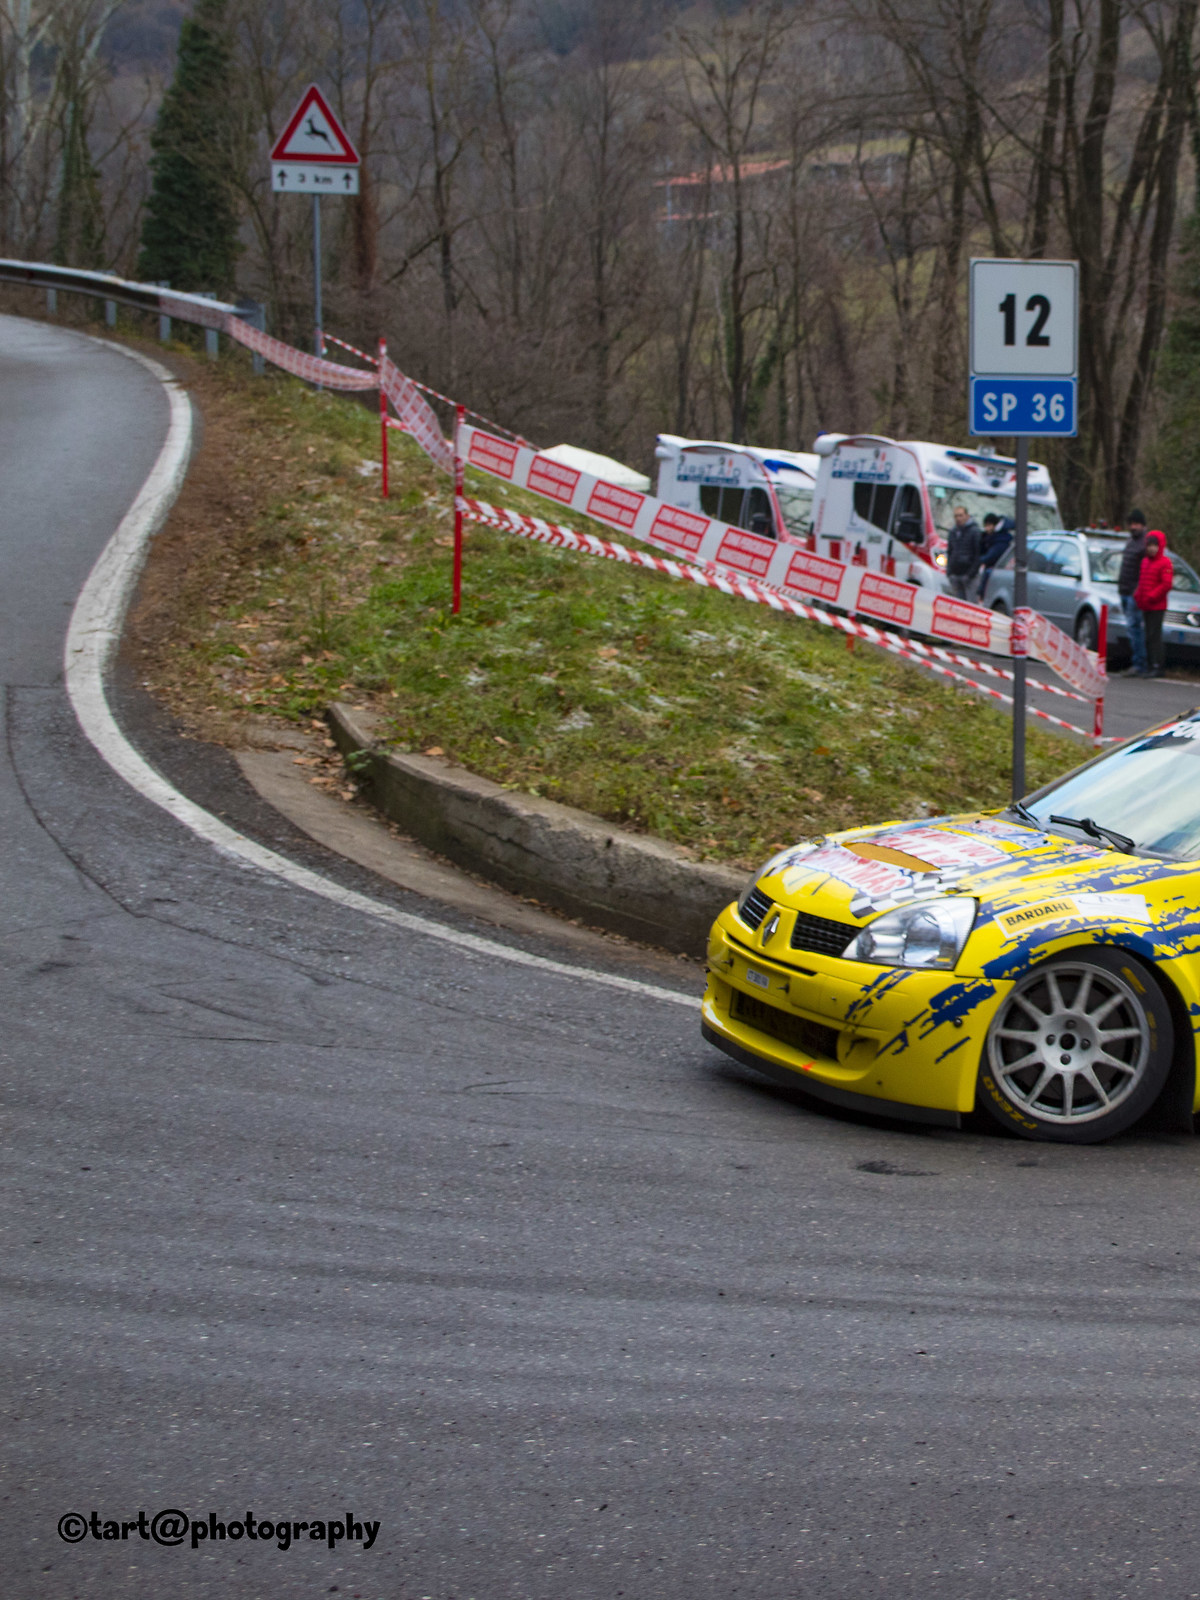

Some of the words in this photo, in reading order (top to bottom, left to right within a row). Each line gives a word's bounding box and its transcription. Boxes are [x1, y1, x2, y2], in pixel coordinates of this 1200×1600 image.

[298, 172, 306, 184] 3
[314, 174, 333, 185] km
[998, 293, 1051, 346] 12
[982, 392, 1018, 422] SP
[1031, 393, 1065, 422] 36
[1005, 902, 1073, 927] BARDAHL
